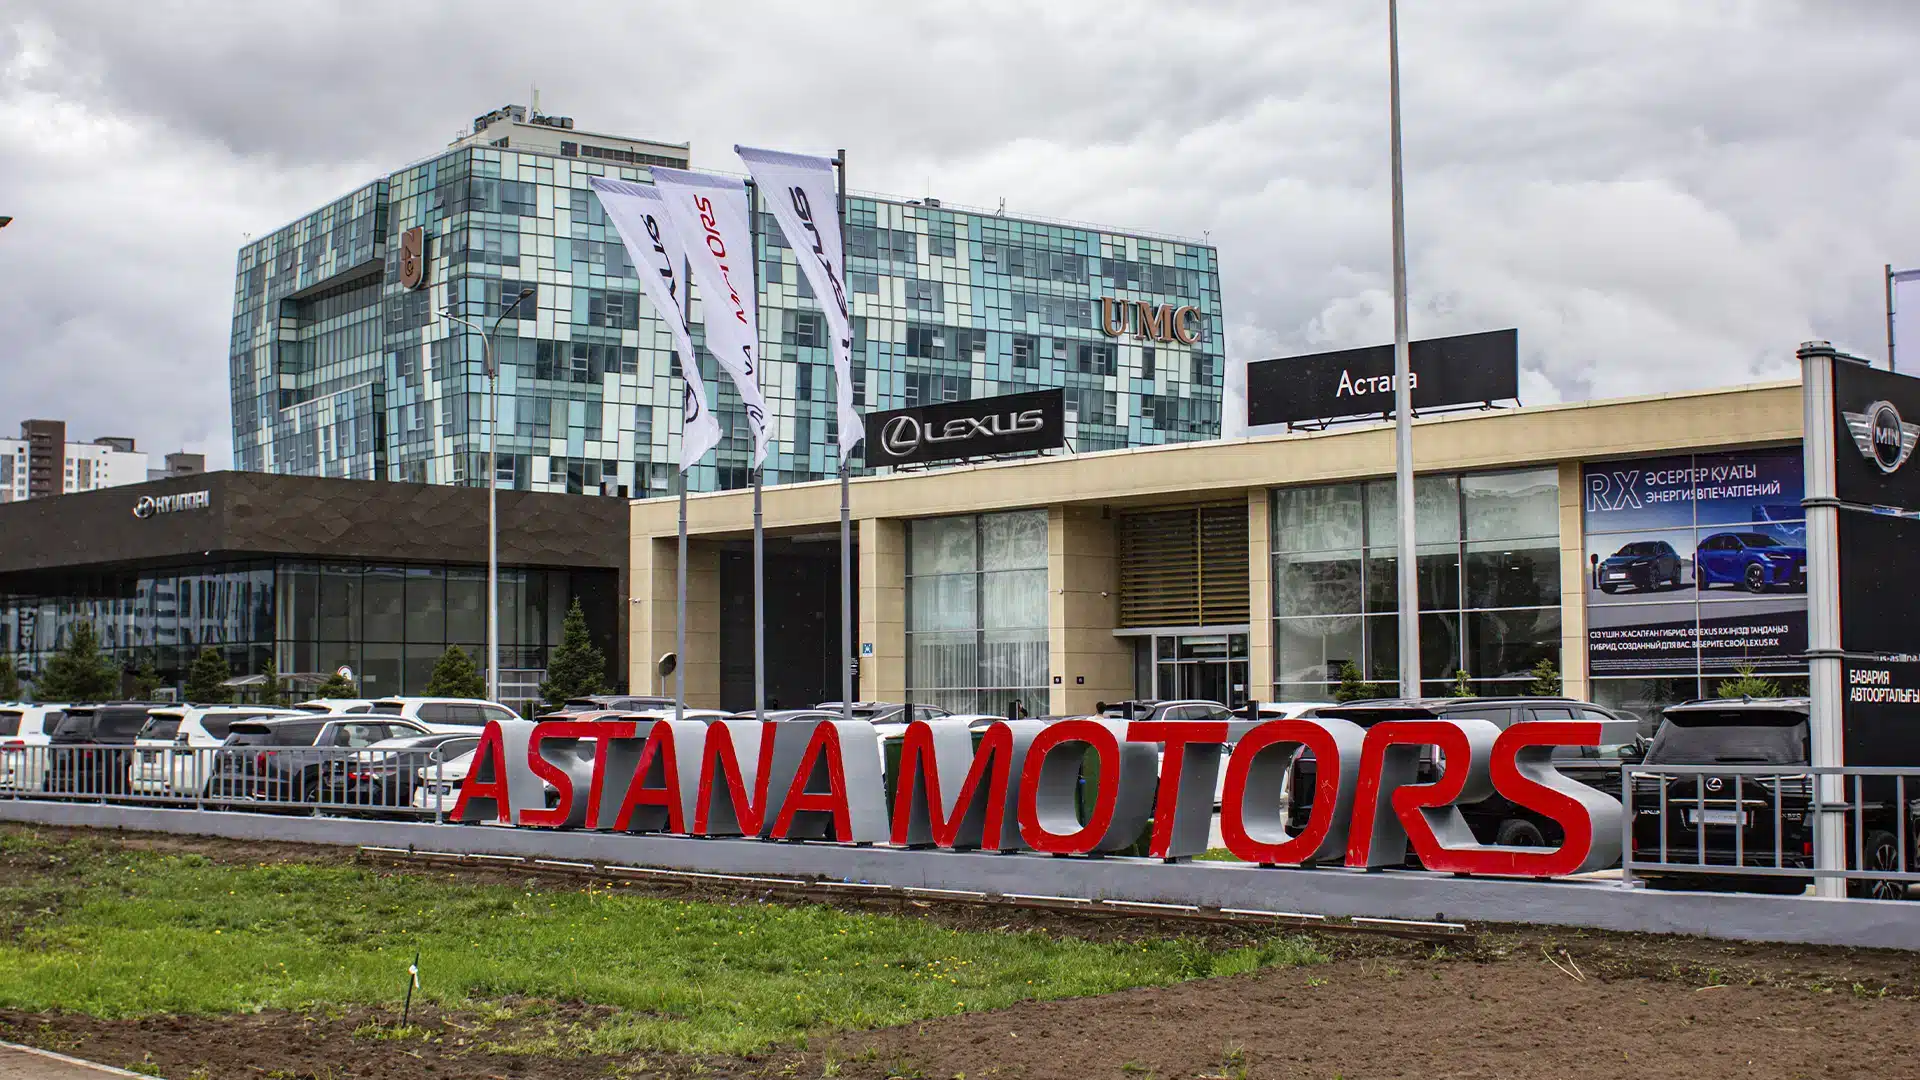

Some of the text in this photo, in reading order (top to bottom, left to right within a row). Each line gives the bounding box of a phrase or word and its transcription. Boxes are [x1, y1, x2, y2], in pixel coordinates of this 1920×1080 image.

[1100, 296, 1201, 345] UMC
[924, 408, 1043, 443] LEXUS
[1645, 464, 1757, 486] ӘСЕРЛЕР ҚУАТЫ
[1586, 470, 1642, 512] RX
[1645, 480, 1781, 503] ЭНЕРГИЯ ВПЕЧАТЛЕНИЙ
[1698, 628, 1718, 636] EXUS
[1617, 641, 1661, 651] СОЗДАННЫЙ
[1661, 641, 1676, 650] ДЛЯ
[1724, 638, 1745, 647] СВОЙ
[1769, 638, 1780, 646] RX
[1849, 669, 1890, 685] БАВАРИЯ
[450, 719, 1603, 876] ASTANA MOTORS
